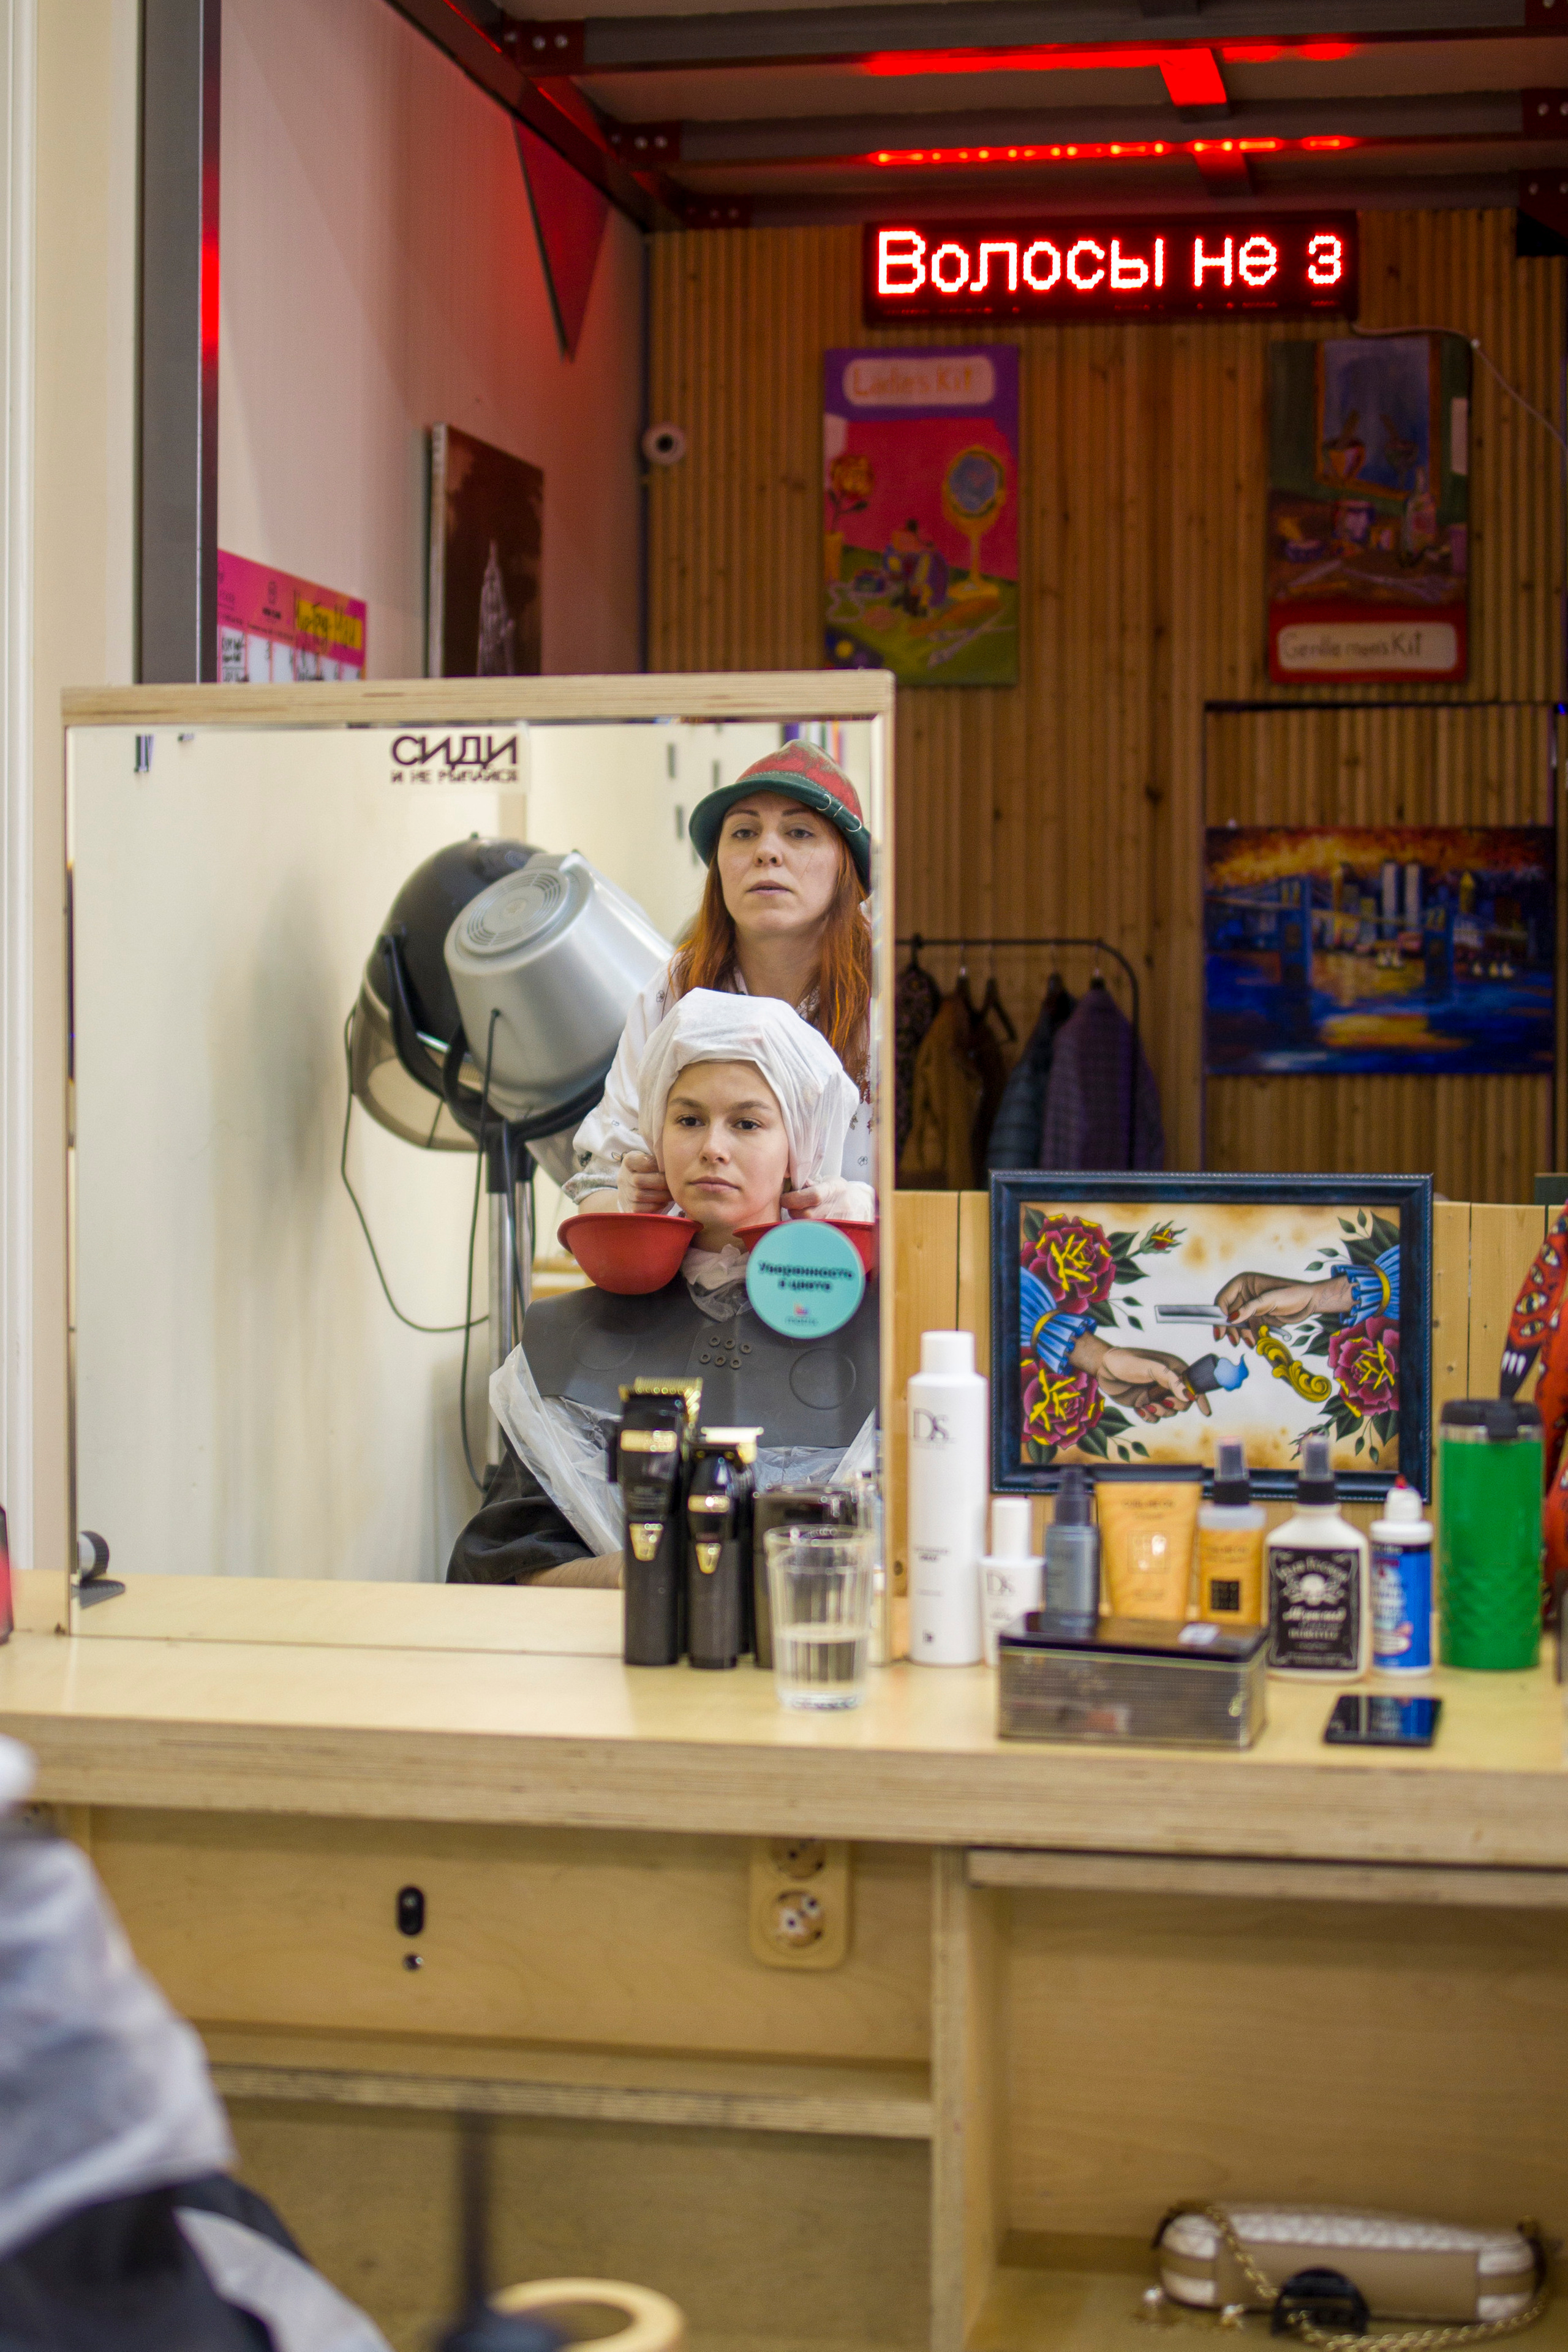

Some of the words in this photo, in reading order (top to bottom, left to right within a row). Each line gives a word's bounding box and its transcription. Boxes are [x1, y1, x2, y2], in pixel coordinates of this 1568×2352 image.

[878, 230, 1164, 294] Волосы
[1193, 236, 1278, 287] не
[392, 735, 517, 770] СИДИ
